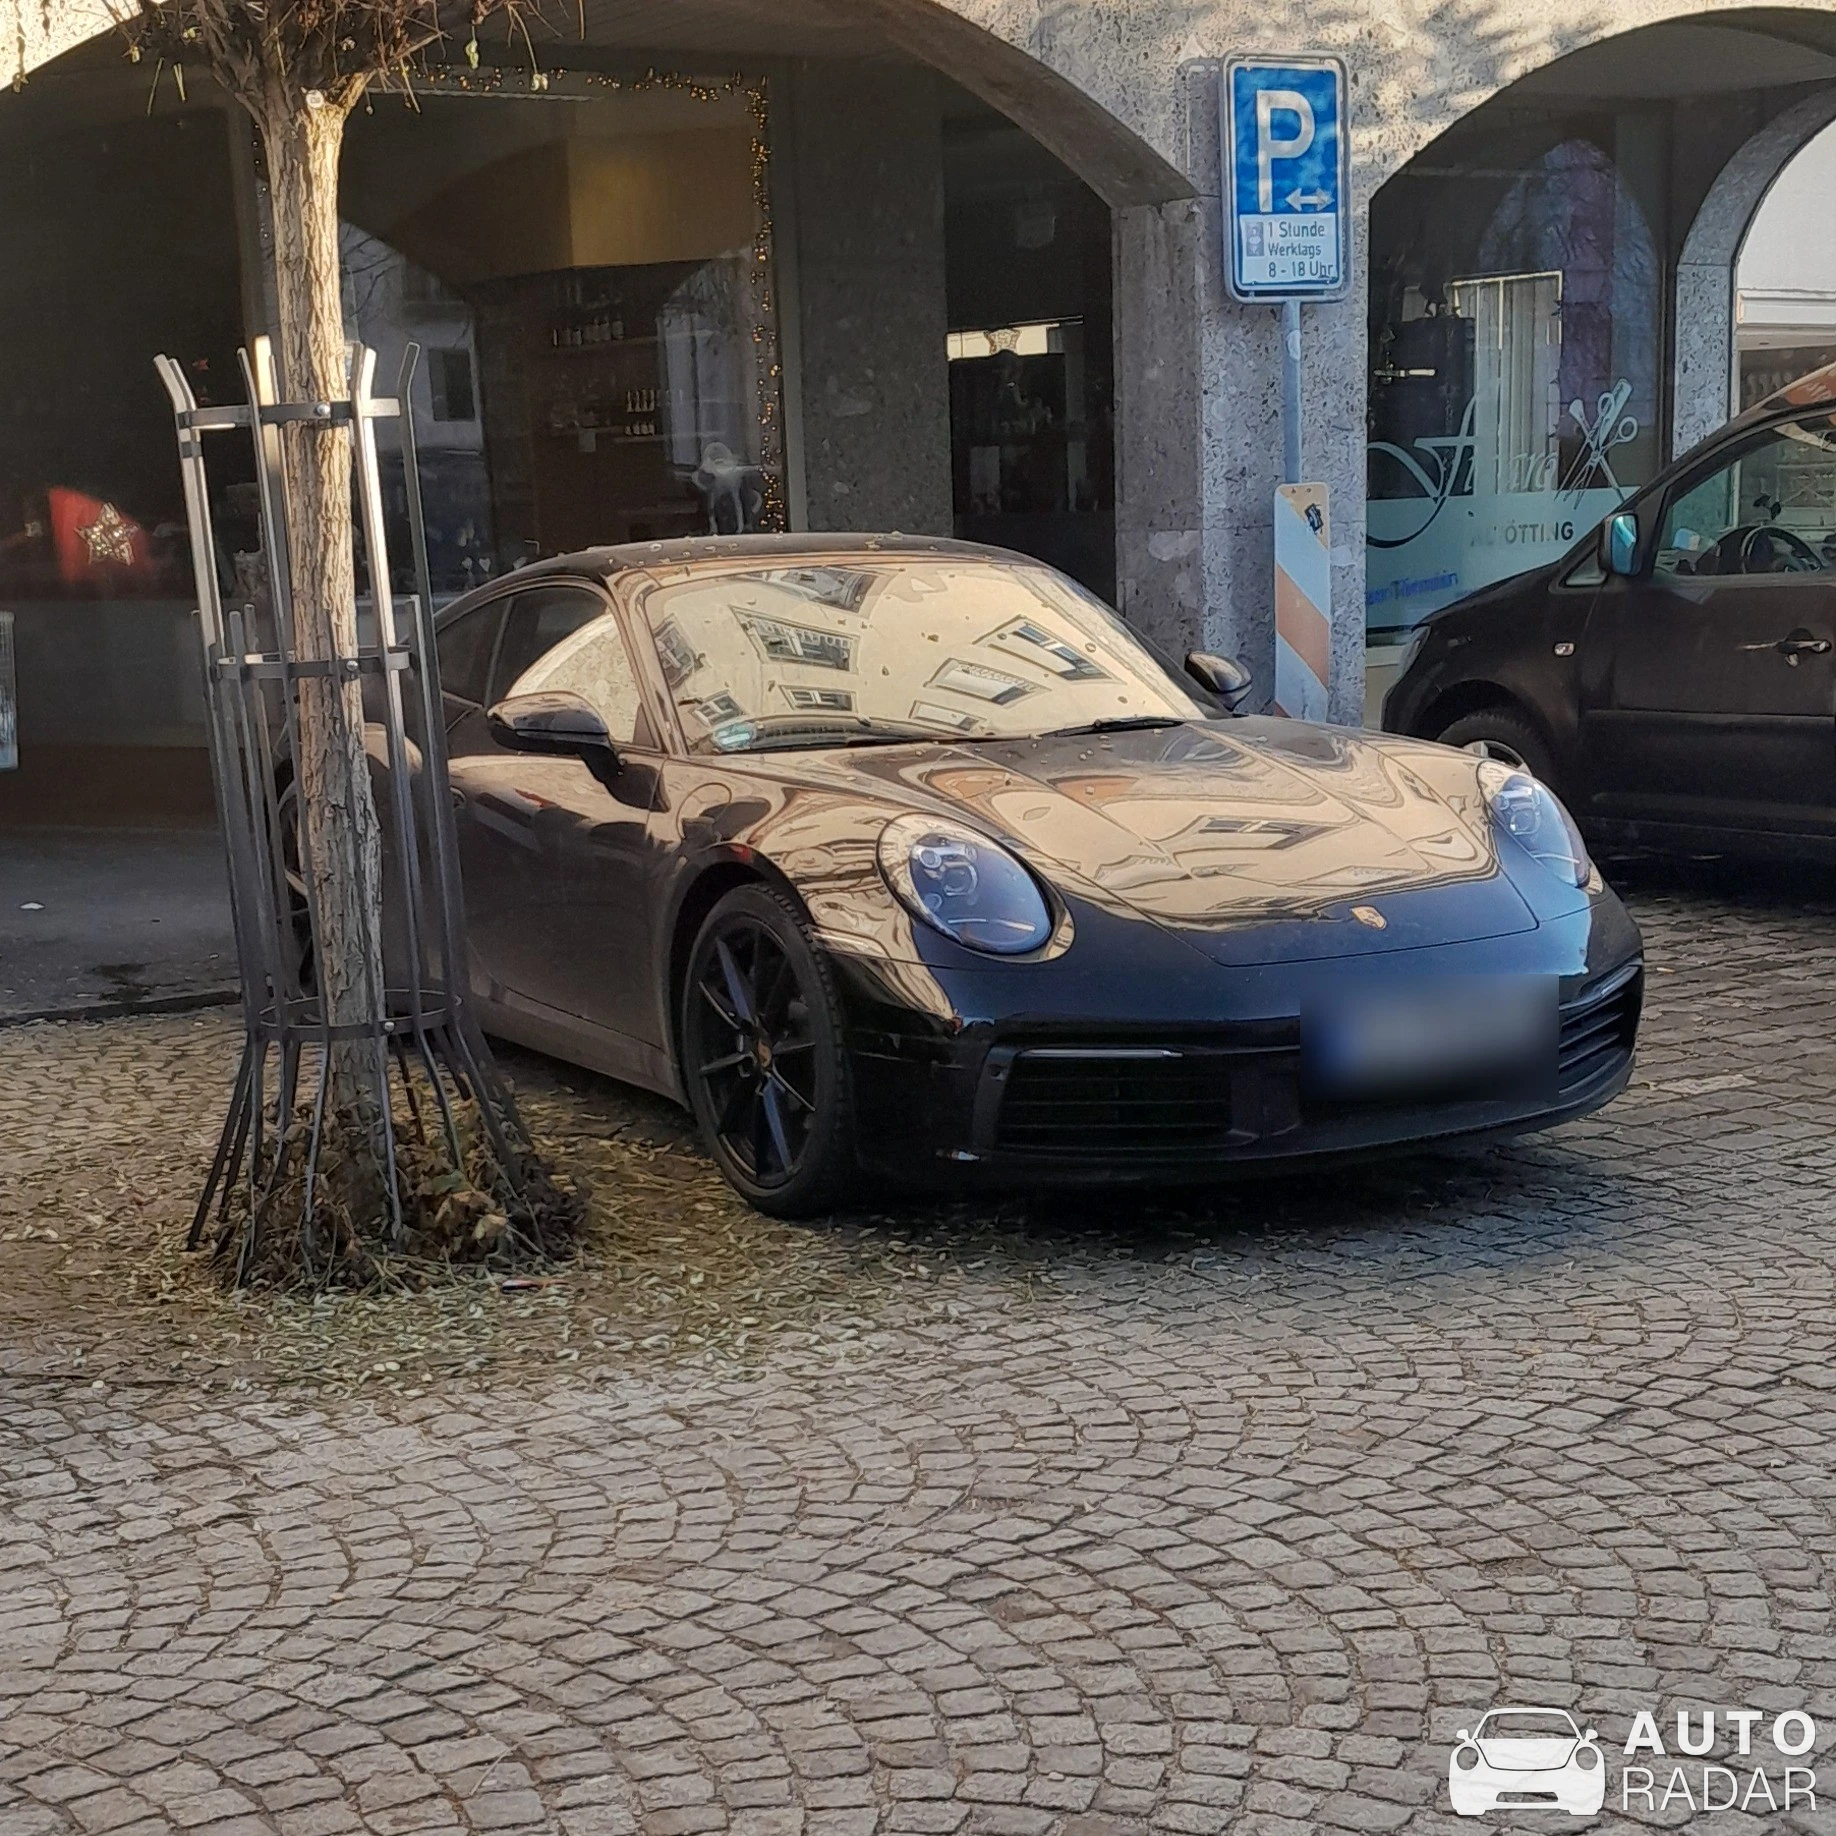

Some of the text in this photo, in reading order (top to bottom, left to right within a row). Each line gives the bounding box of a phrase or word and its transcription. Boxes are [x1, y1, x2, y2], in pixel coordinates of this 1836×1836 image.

[1256, 89, 1316, 212] P
[1268, 220, 1325, 238] 1 Stunde
[1267, 242, 1322, 259] Werktags
[1268, 261, 1277, 278] 8
[1292, 260, 1306, 277] 18
[1309, 260, 1334, 278] Uhr
